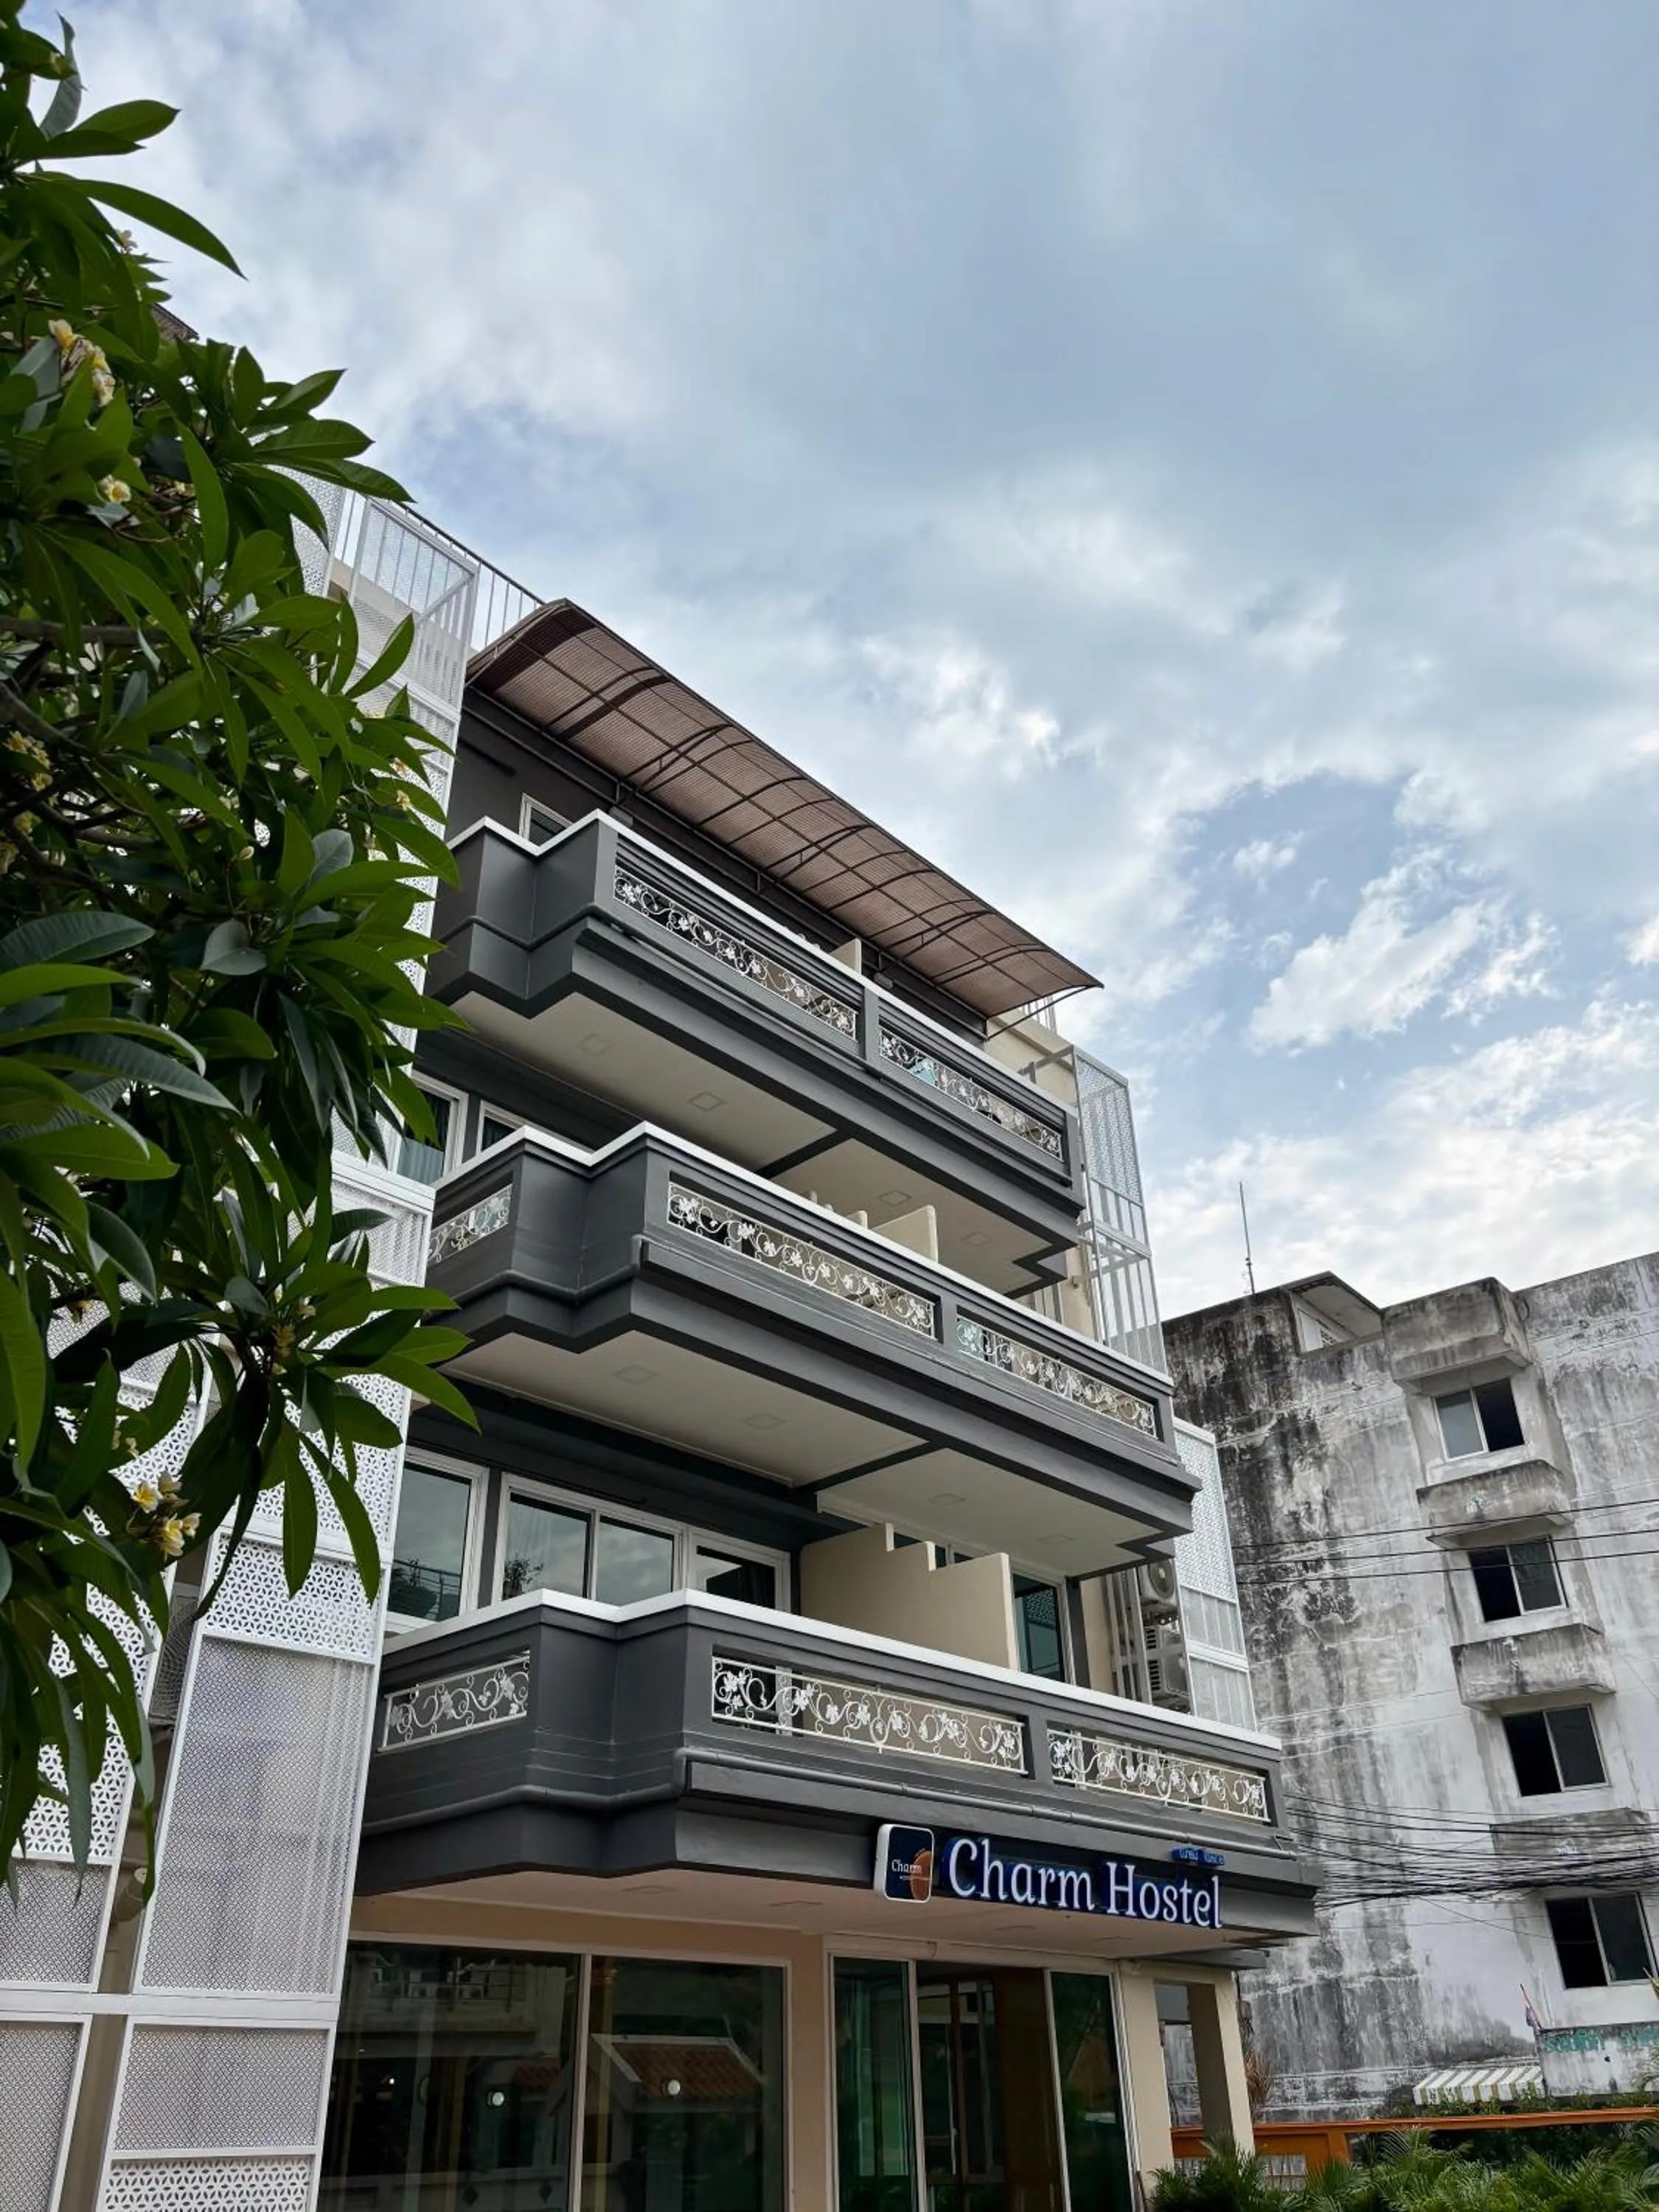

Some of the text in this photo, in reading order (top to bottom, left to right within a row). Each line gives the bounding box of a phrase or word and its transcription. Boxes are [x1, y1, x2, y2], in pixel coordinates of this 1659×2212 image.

[891, 1859, 922, 1874] Charm
[949, 1838, 1222, 1928] Charm Hostel
